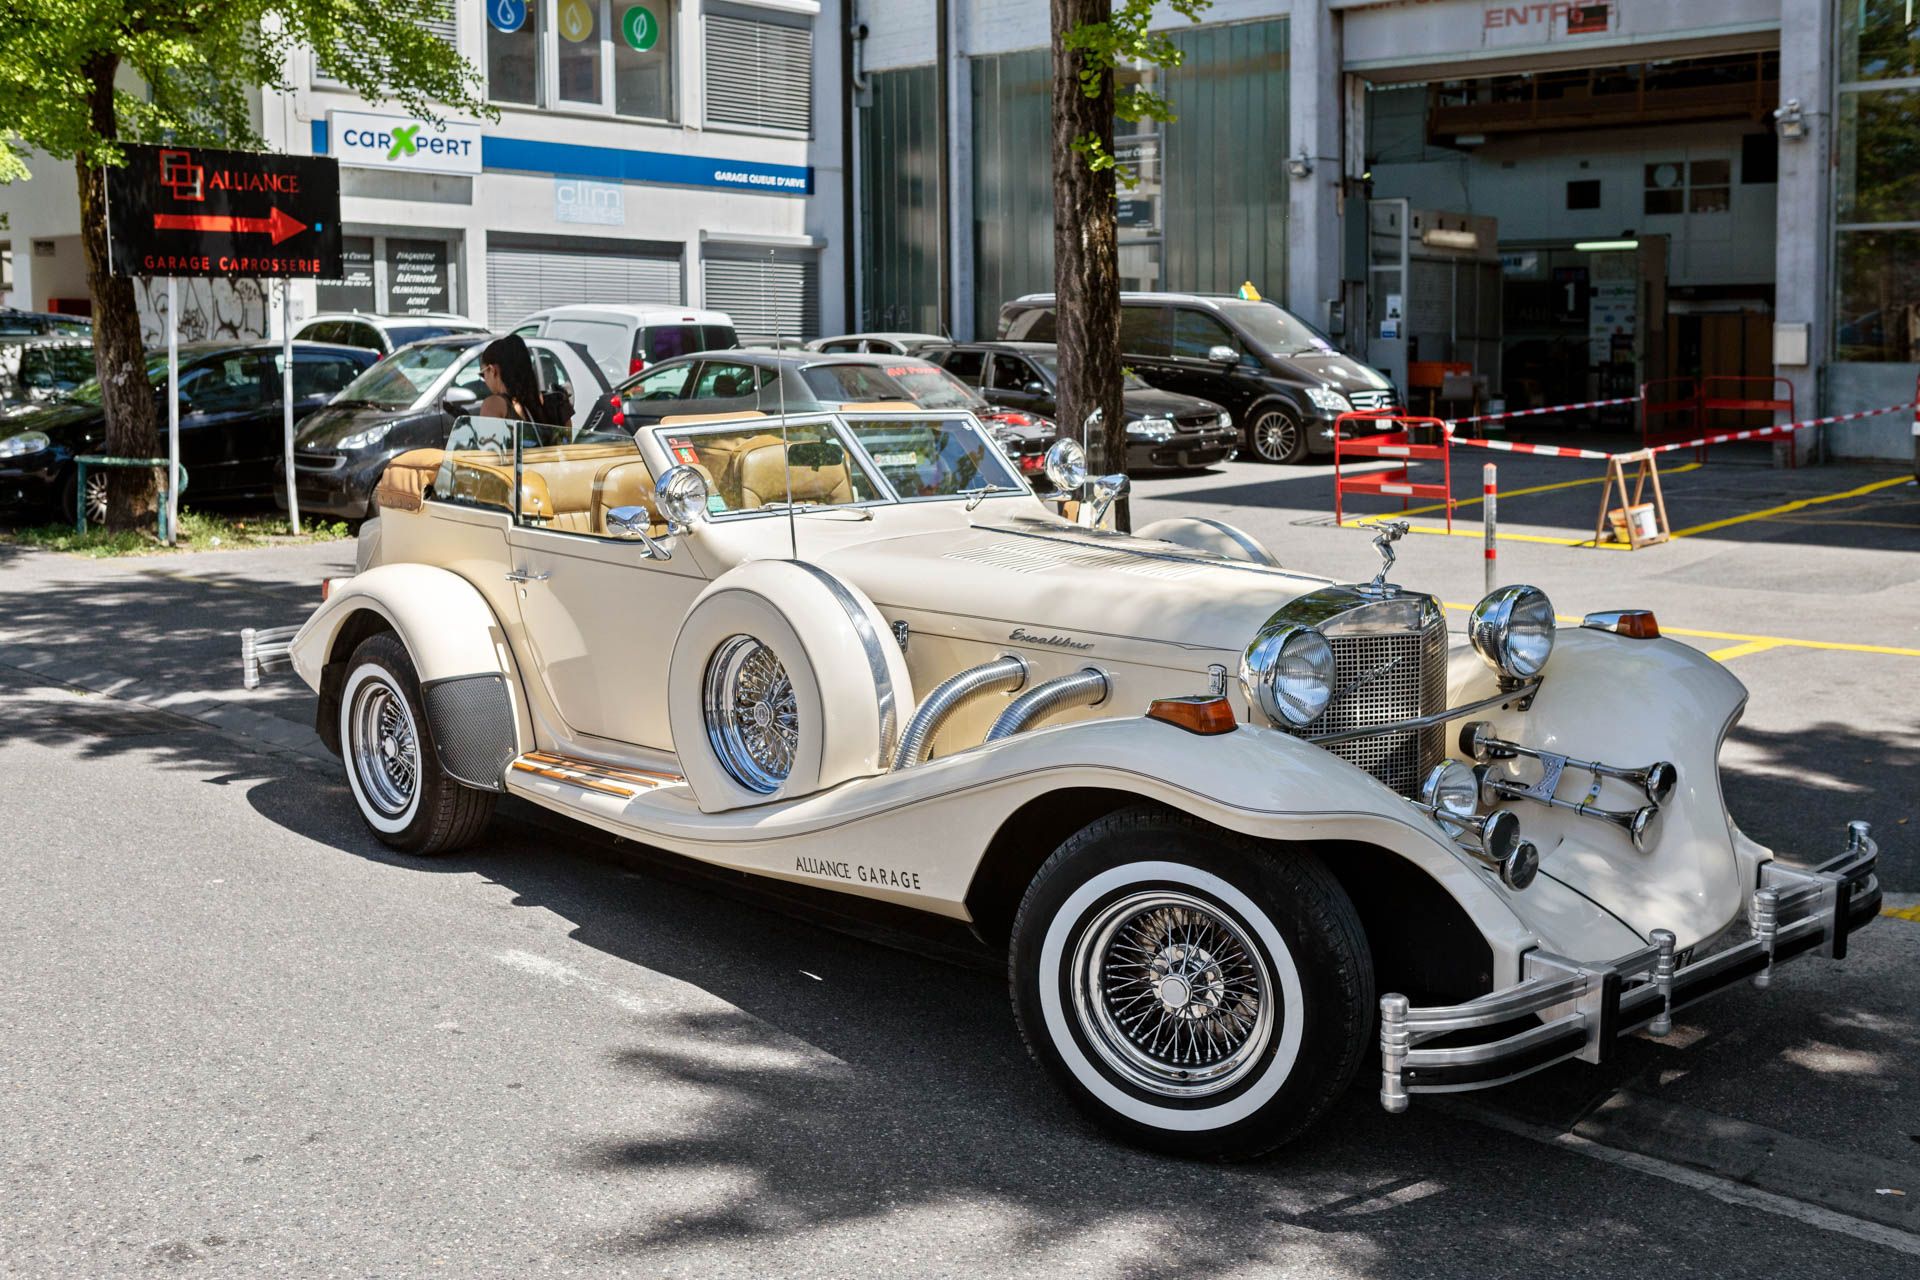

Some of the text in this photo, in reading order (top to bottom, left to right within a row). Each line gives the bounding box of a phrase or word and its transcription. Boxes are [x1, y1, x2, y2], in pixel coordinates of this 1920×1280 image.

[1485, 0, 1616, 28] ENTR
[209, 170, 300, 193] ALLIANCE
[714, 171, 805, 188] GARAGE QUEUE D'ARVE
[557, 181, 620, 208] clim
[144, 255, 321, 272] GARAGE CARROSSERIE
[406, 297, 430, 305] ACHAT
[1009, 628, 1096, 650] Excalibur
[796, 856, 921, 889] ALLIANCE GARAGE
